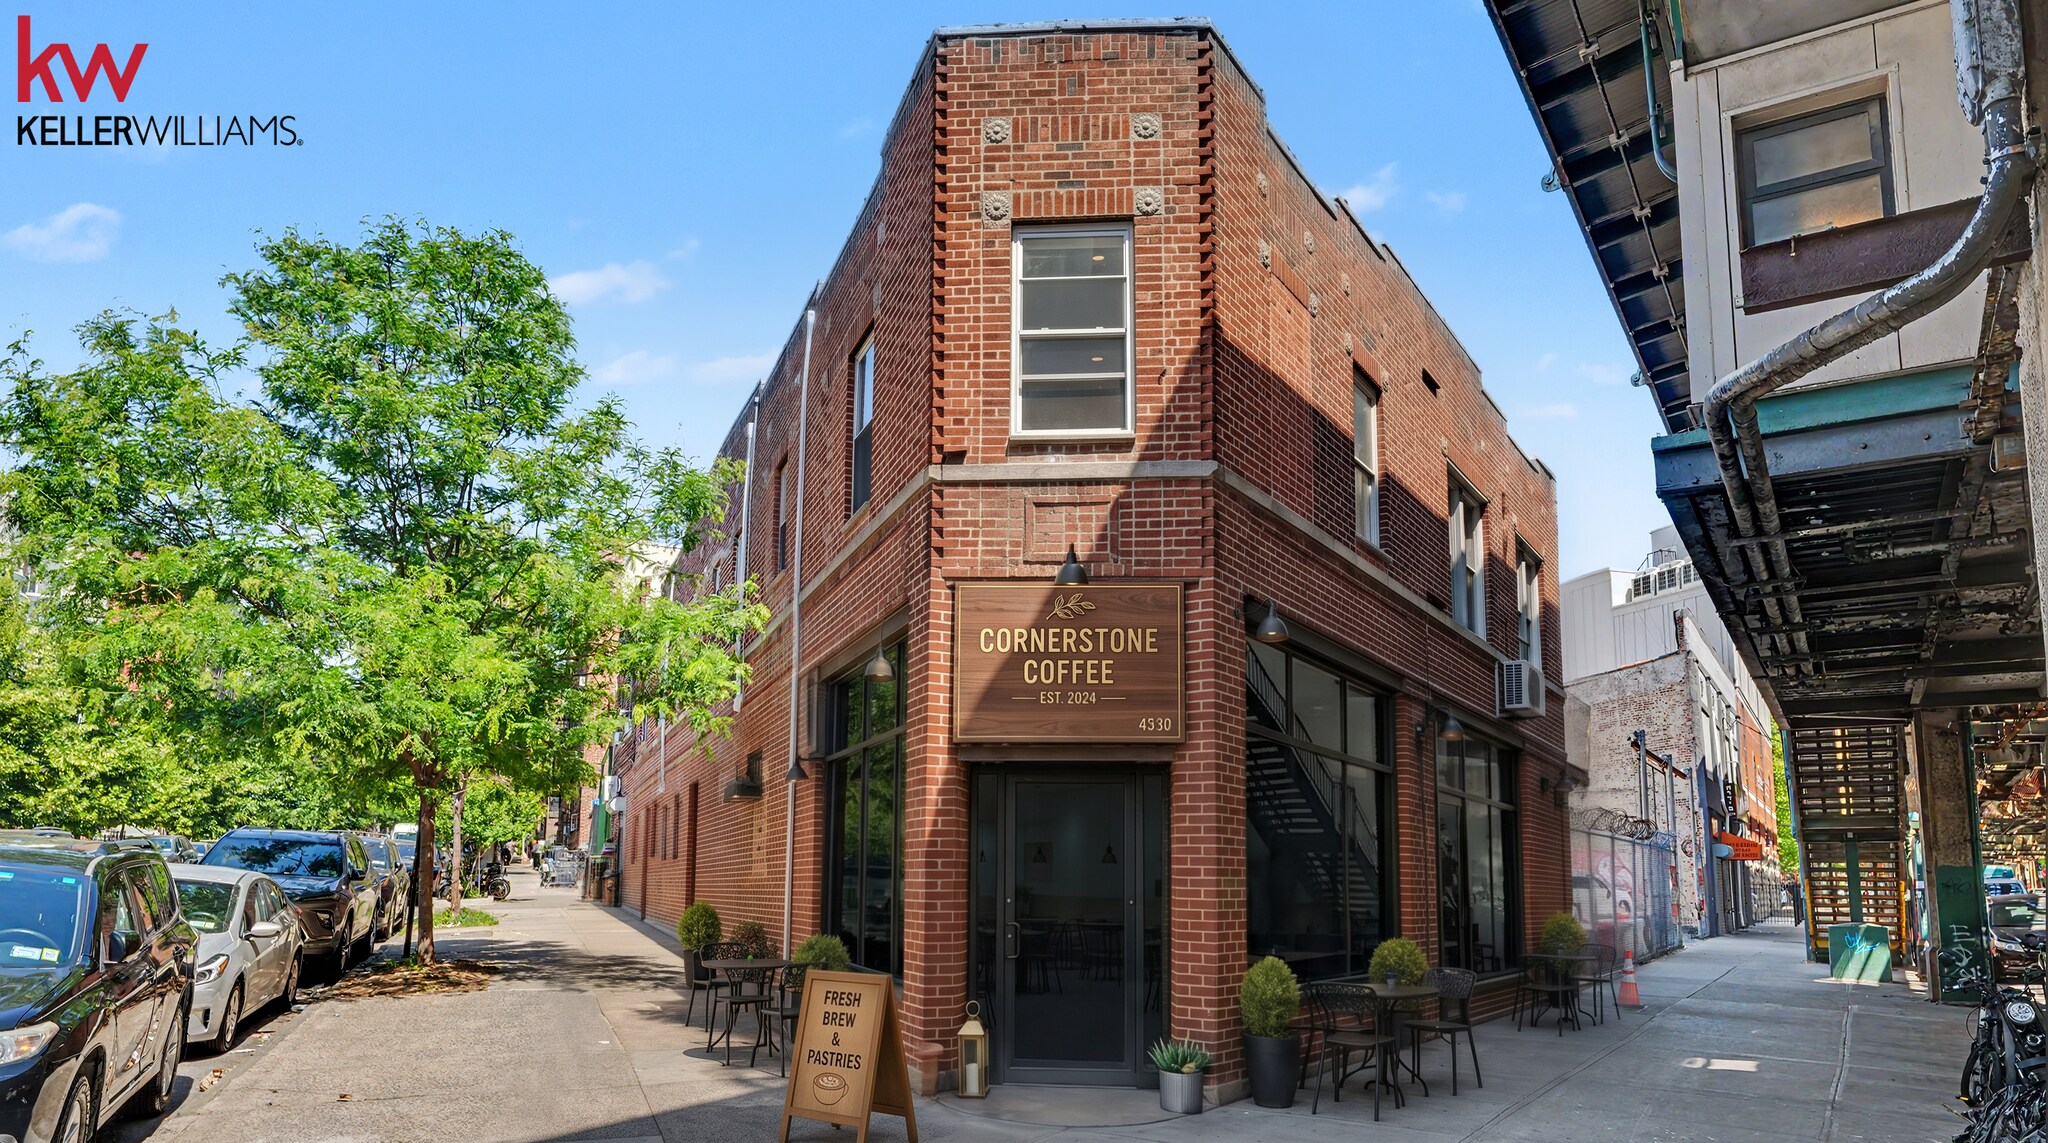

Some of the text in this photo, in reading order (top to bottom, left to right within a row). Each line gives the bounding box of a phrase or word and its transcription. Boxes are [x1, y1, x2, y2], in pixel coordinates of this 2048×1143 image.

[979, 628, 1158, 653] CORNERSTONE
[1023, 659, 1114, 685] COFFEE
[1040, 691, 1097, 704] EST. 2024
[823, 990, 862, 1008] FRESH
[822, 1011, 857, 1028] BREW
[831, 1032, 841, 1047] &
[807, 1049, 862, 1070] PASTRIES
